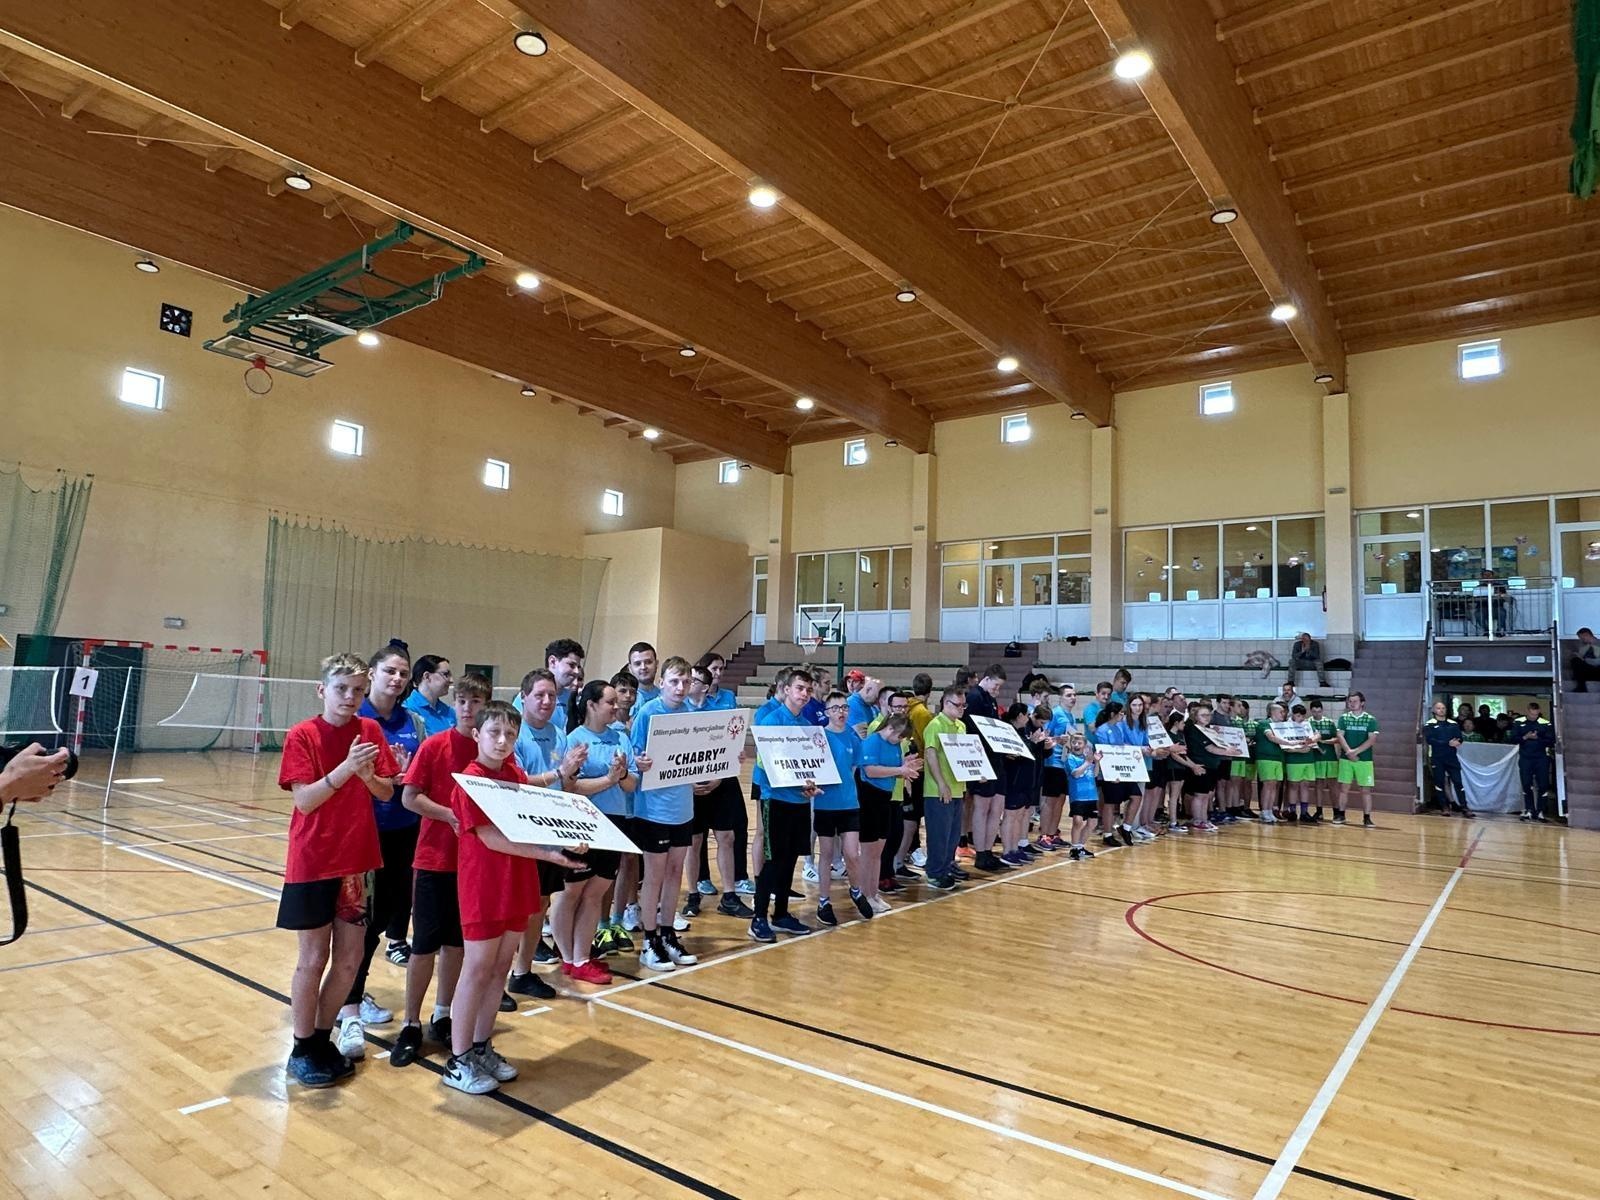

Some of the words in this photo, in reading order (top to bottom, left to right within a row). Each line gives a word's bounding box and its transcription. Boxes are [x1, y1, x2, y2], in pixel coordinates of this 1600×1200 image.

[81, 675, 90, 690] 1
[653, 727, 690, 737] Olimpiady
[692, 724, 726, 733] Specjalne
[659, 766, 704, 781] WODZISŁAW
[705, 761, 729, 775] ŚLĄSKI
[794, 771, 816, 780] RYBNIK
[556, 829, 594, 842] ZABRZE
